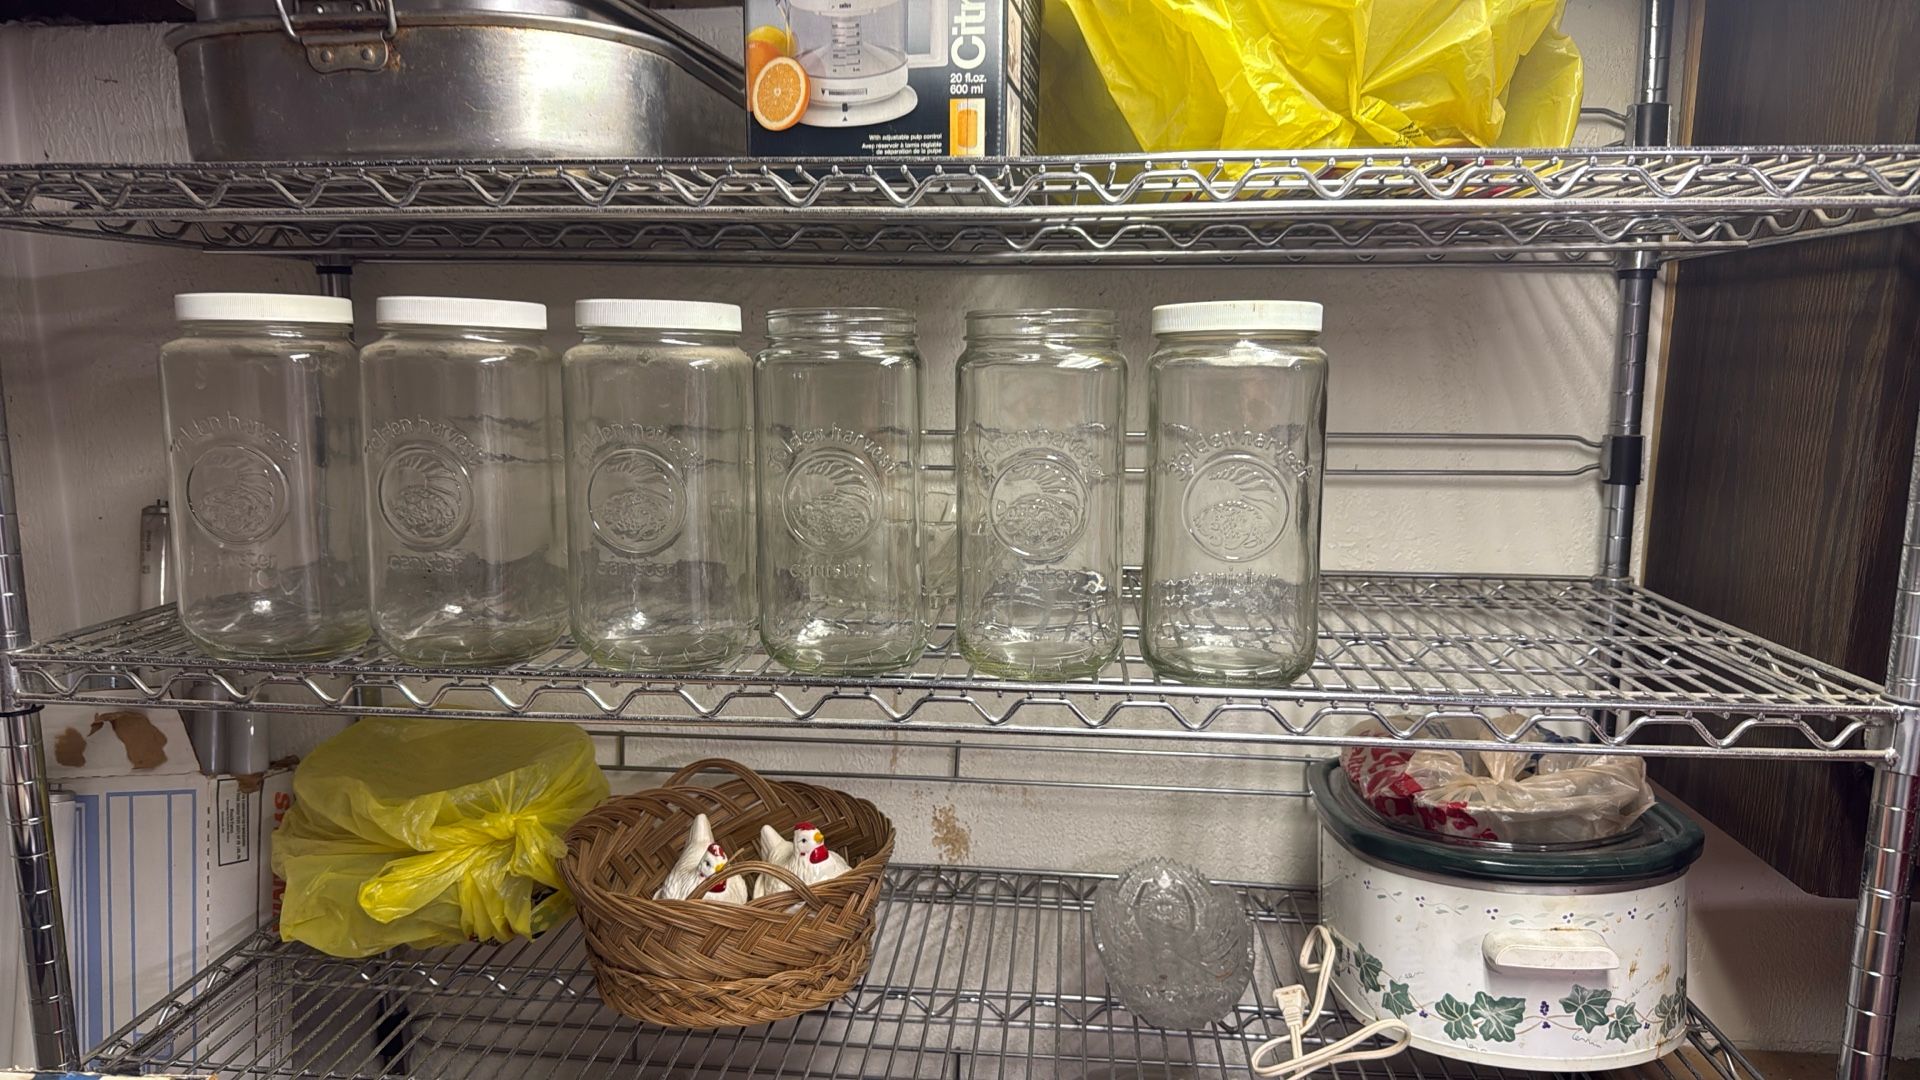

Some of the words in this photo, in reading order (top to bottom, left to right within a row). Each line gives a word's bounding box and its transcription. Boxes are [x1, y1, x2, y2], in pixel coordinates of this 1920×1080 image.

[950, 72, 963, 84] 20
[950, 84, 968, 95] 600
[971, 83, 984, 94] ml
[882, 133, 910, 141] adjustable
[910, 133, 922, 141] pulp
[923, 132, 942, 140] control
